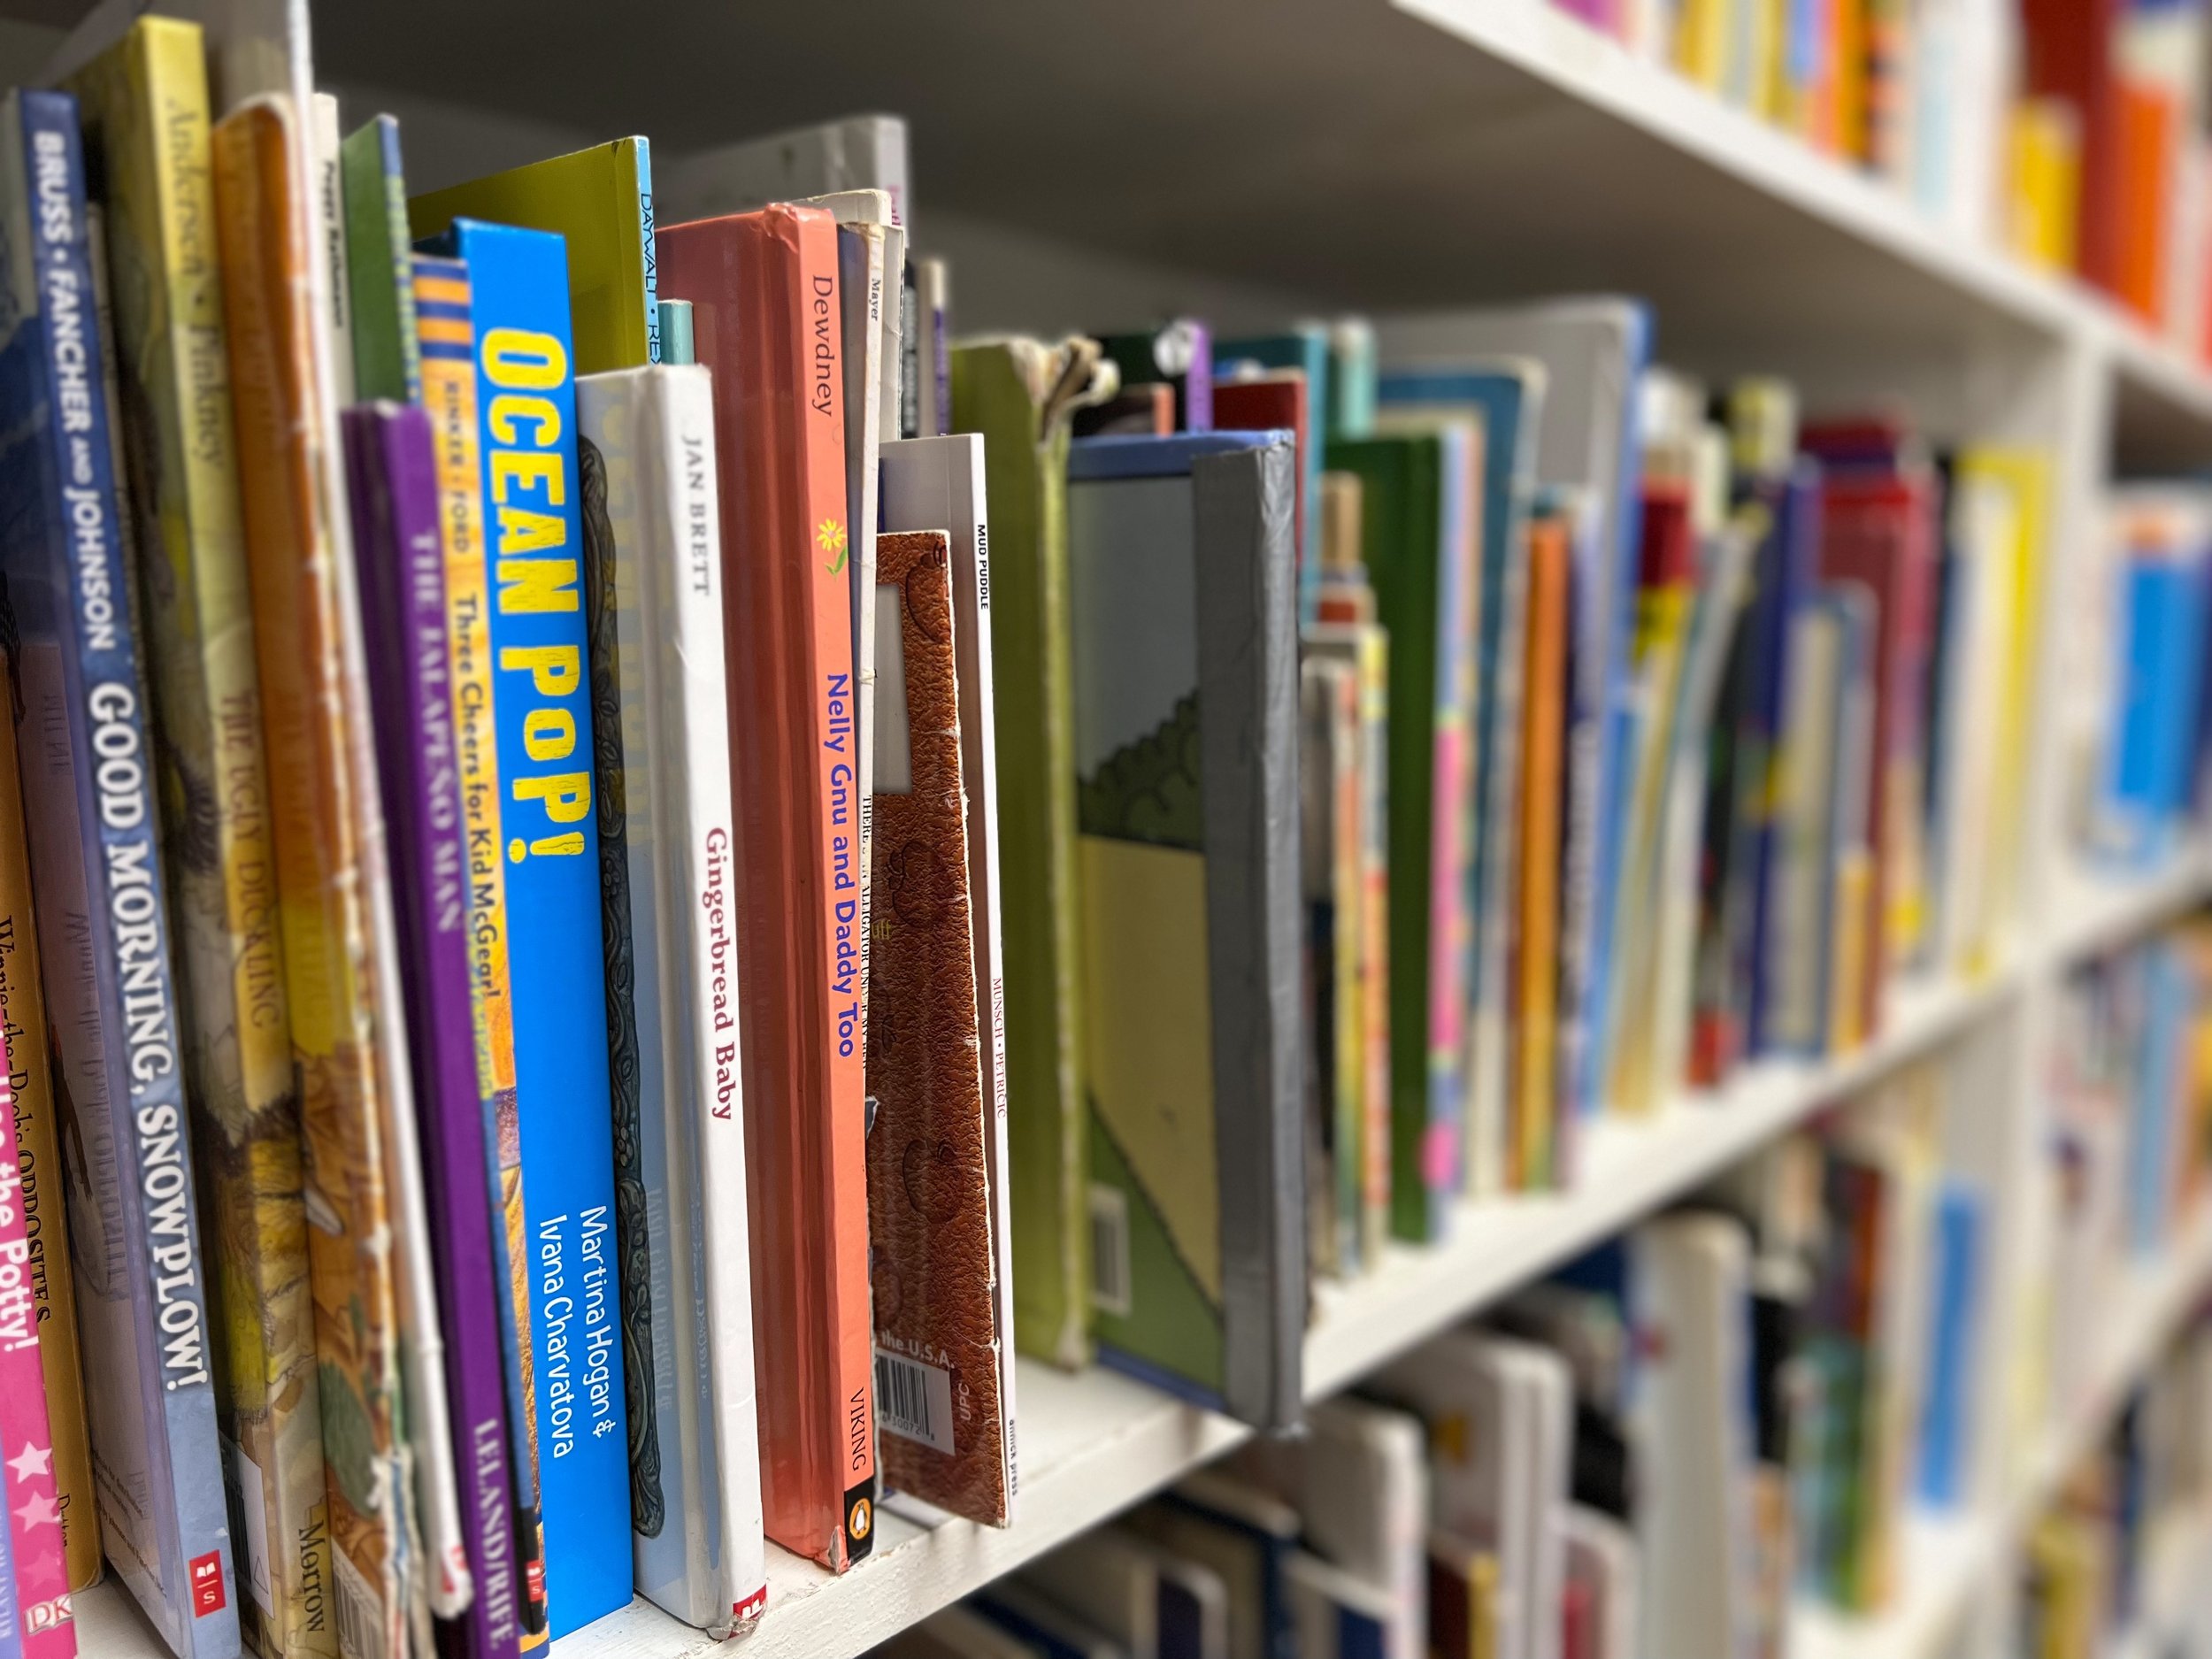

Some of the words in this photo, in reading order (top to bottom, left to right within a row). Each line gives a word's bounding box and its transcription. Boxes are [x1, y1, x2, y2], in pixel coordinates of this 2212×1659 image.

[34, 130, 73, 242] BRUSS
[641, 193, 657, 301] DAYWALT
[870, 278, 882, 321] Mayer
[48, 268, 92, 433] FANCHER
[812, 274, 834, 418] Dewdney
[482, 329, 578, 613] OCEAN
[681, 435, 703, 493] JAN
[451, 491, 470, 553] FORD
[689, 503, 709, 596] BRETT
[977, 523, 987, 557] MUD
[65, 488, 117, 650] JOHNSON
[979, 559, 988, 611] PUDDLE
[455, 593, 479, 673] Three
[410, 534, 441, 611] THE
[432, 838, 462, 933] MAN
[459, 681, 485, 777] Cheers
[500, 646, 591, 864] POP!
[824, 672, 849, 754] Nelly
[88, 682, 145, 830] GOOD
[830, 763, 853, 826] Gnu
[466, 783, 488, 821] for
[469, 828, 493, 875] Kid
[833, 835, 856, 892] and
[107, 841, 173, 1095] MORNING,
[703, 827, 734, 1033] Gingerbread
[831, 898, 857, 997] Daddy
[836, 1002, 858, 1059] Too
[861, 966, 870, 1013] UNR
[993, 978, 1004, 1039] MUNSCH
[711, 1045, 735, 1121] Baby
[137, 1106, 209, 1392] SNOWPLOW!
[540, 1214, 567, 1299] Ivana
[580, 1205, 609, 1323] Martina
[0, 1237, 40, 1352] Potty!
[545, 1297, 575, 1459] Charvatova
[583, 1325, 613, 1418] Hogan
[881, 1330, 903, 1349] the
[909, 1339, 955, 1369] U.S.A.
[593, 1420, 617, 1439] &
[850, 1386, 866, 1471] VIKING
[958, 1382, 972, 1422] UPC
[29, 1597, 72, 1630] DK
[203, 1590, 216, 1605] S
[298, 1519, 326, 1632] Morrow
